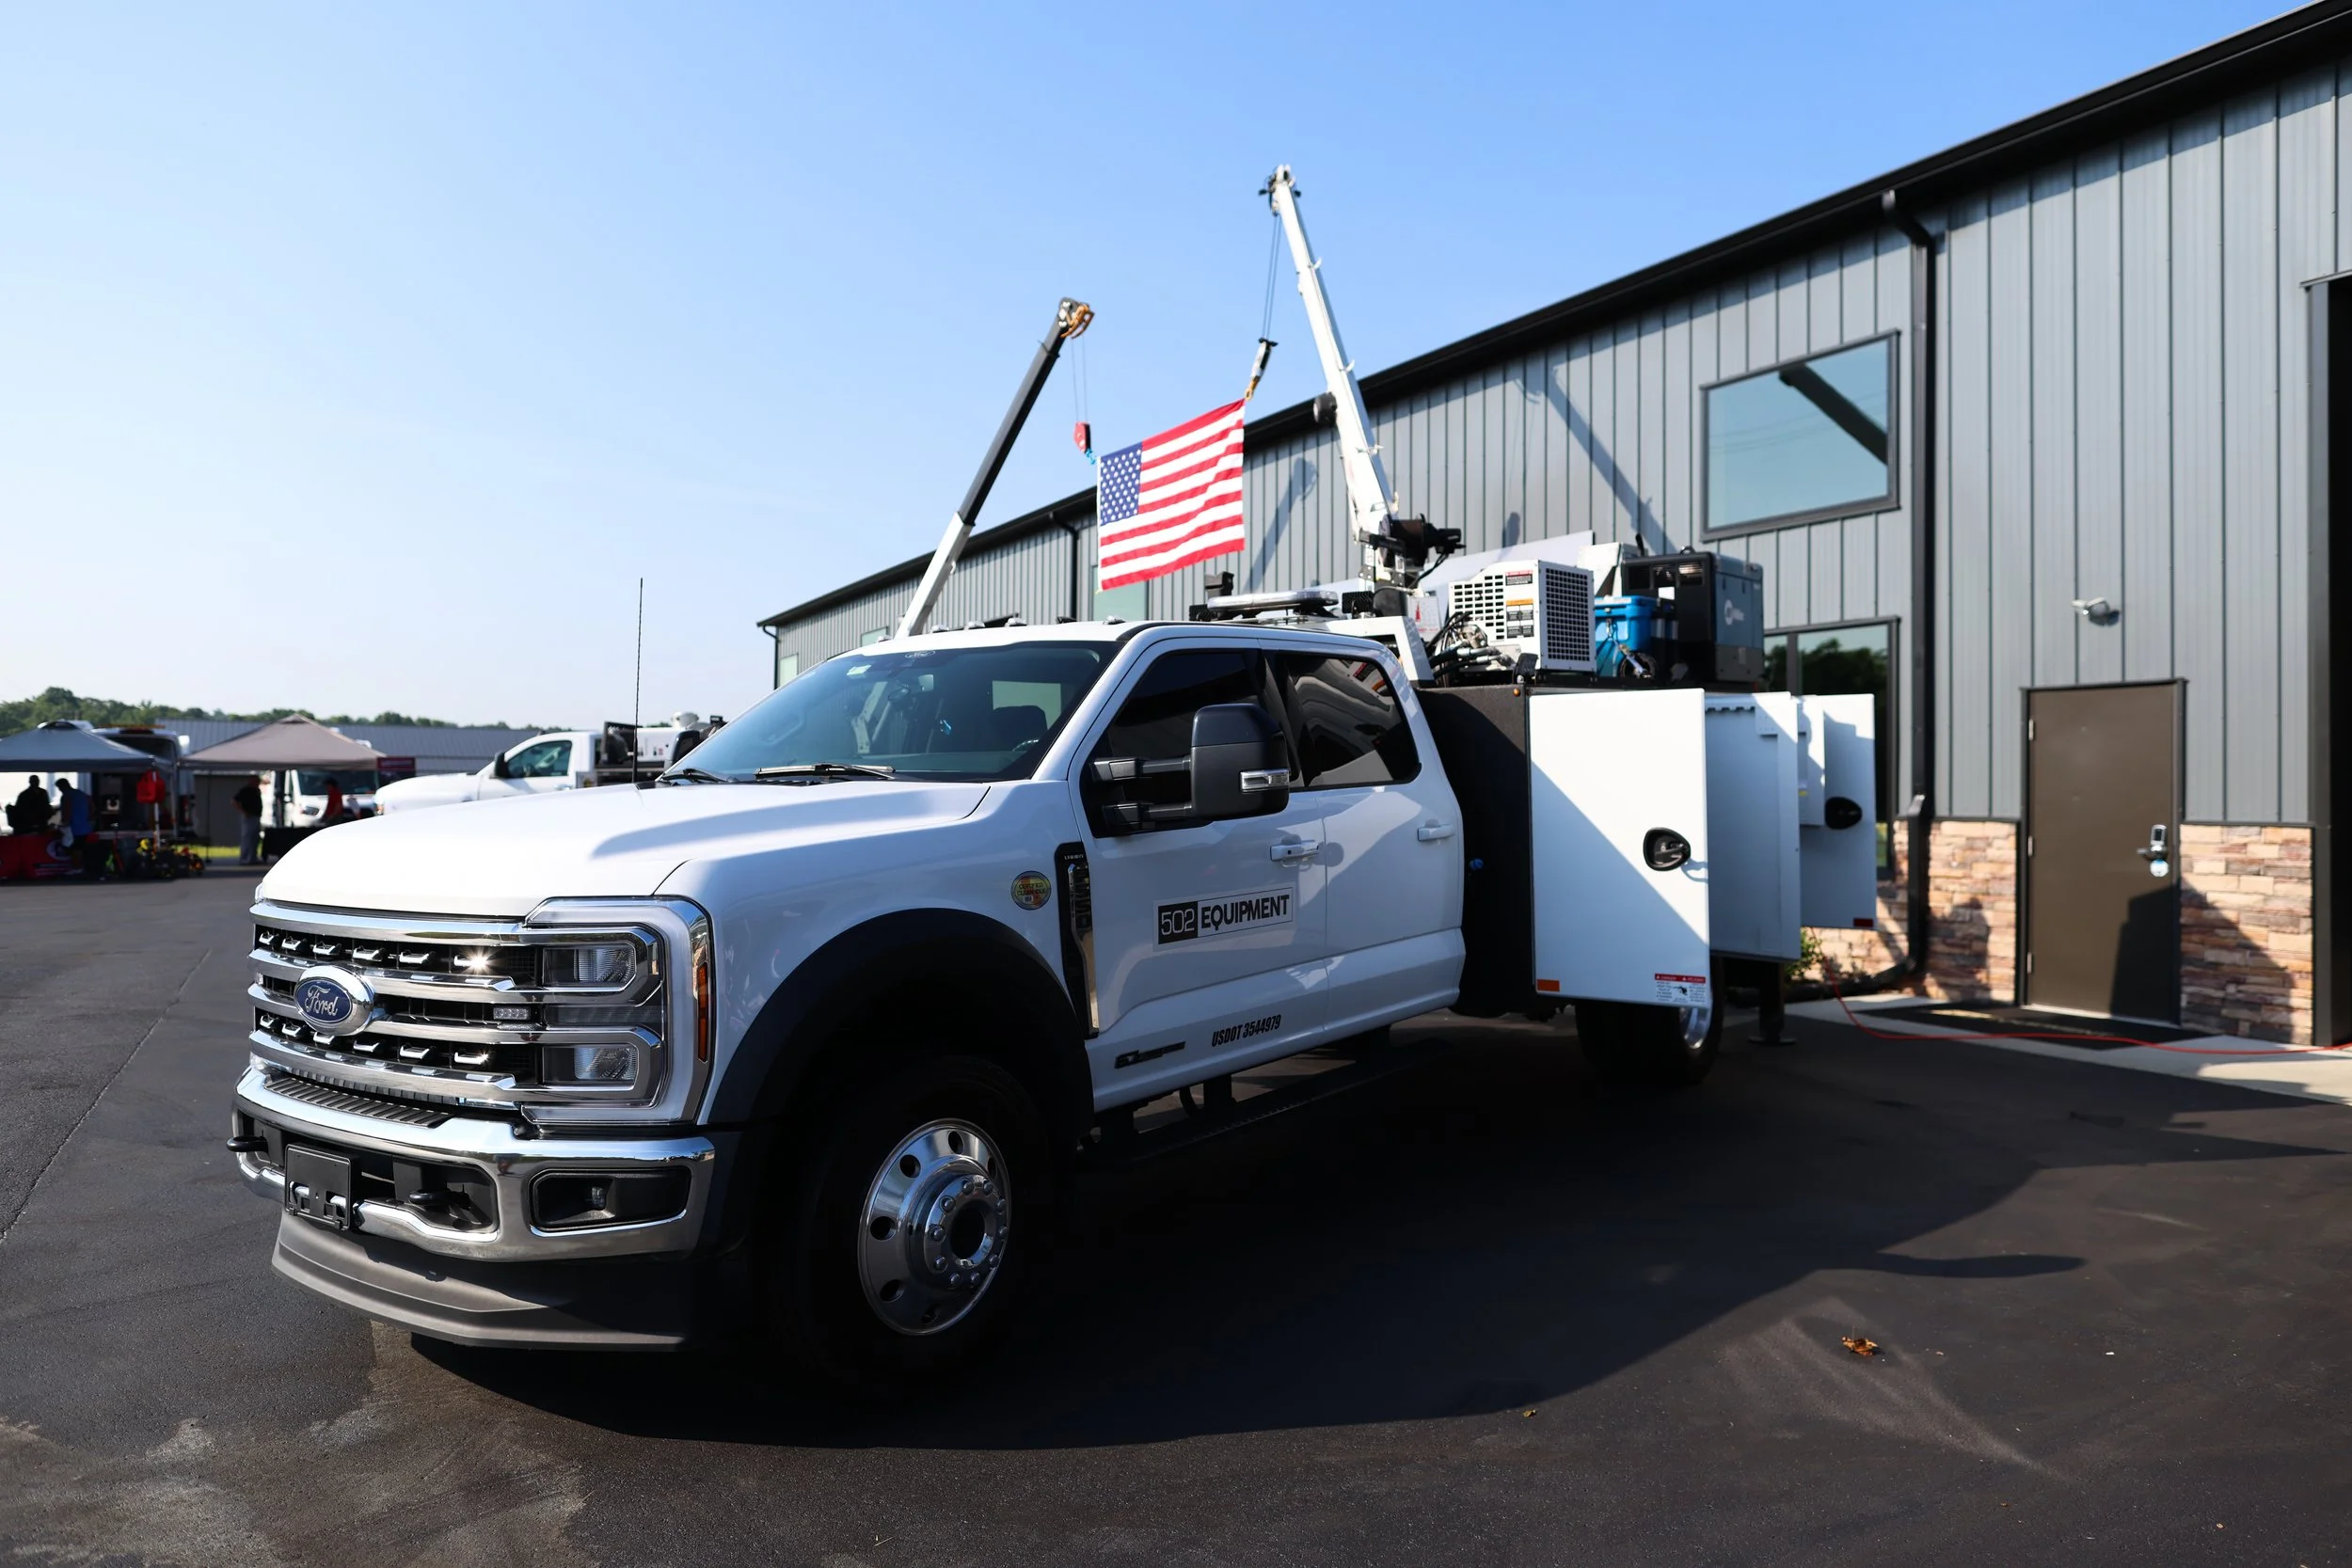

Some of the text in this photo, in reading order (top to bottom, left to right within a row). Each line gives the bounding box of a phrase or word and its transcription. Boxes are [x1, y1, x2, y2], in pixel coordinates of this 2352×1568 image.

[1161, 895, 1290, 936] 502 EQUIPMENT
[304, 984, 339, 1016] Ford
[1212, 1014, 1281, 1047] USDOT 3544979
